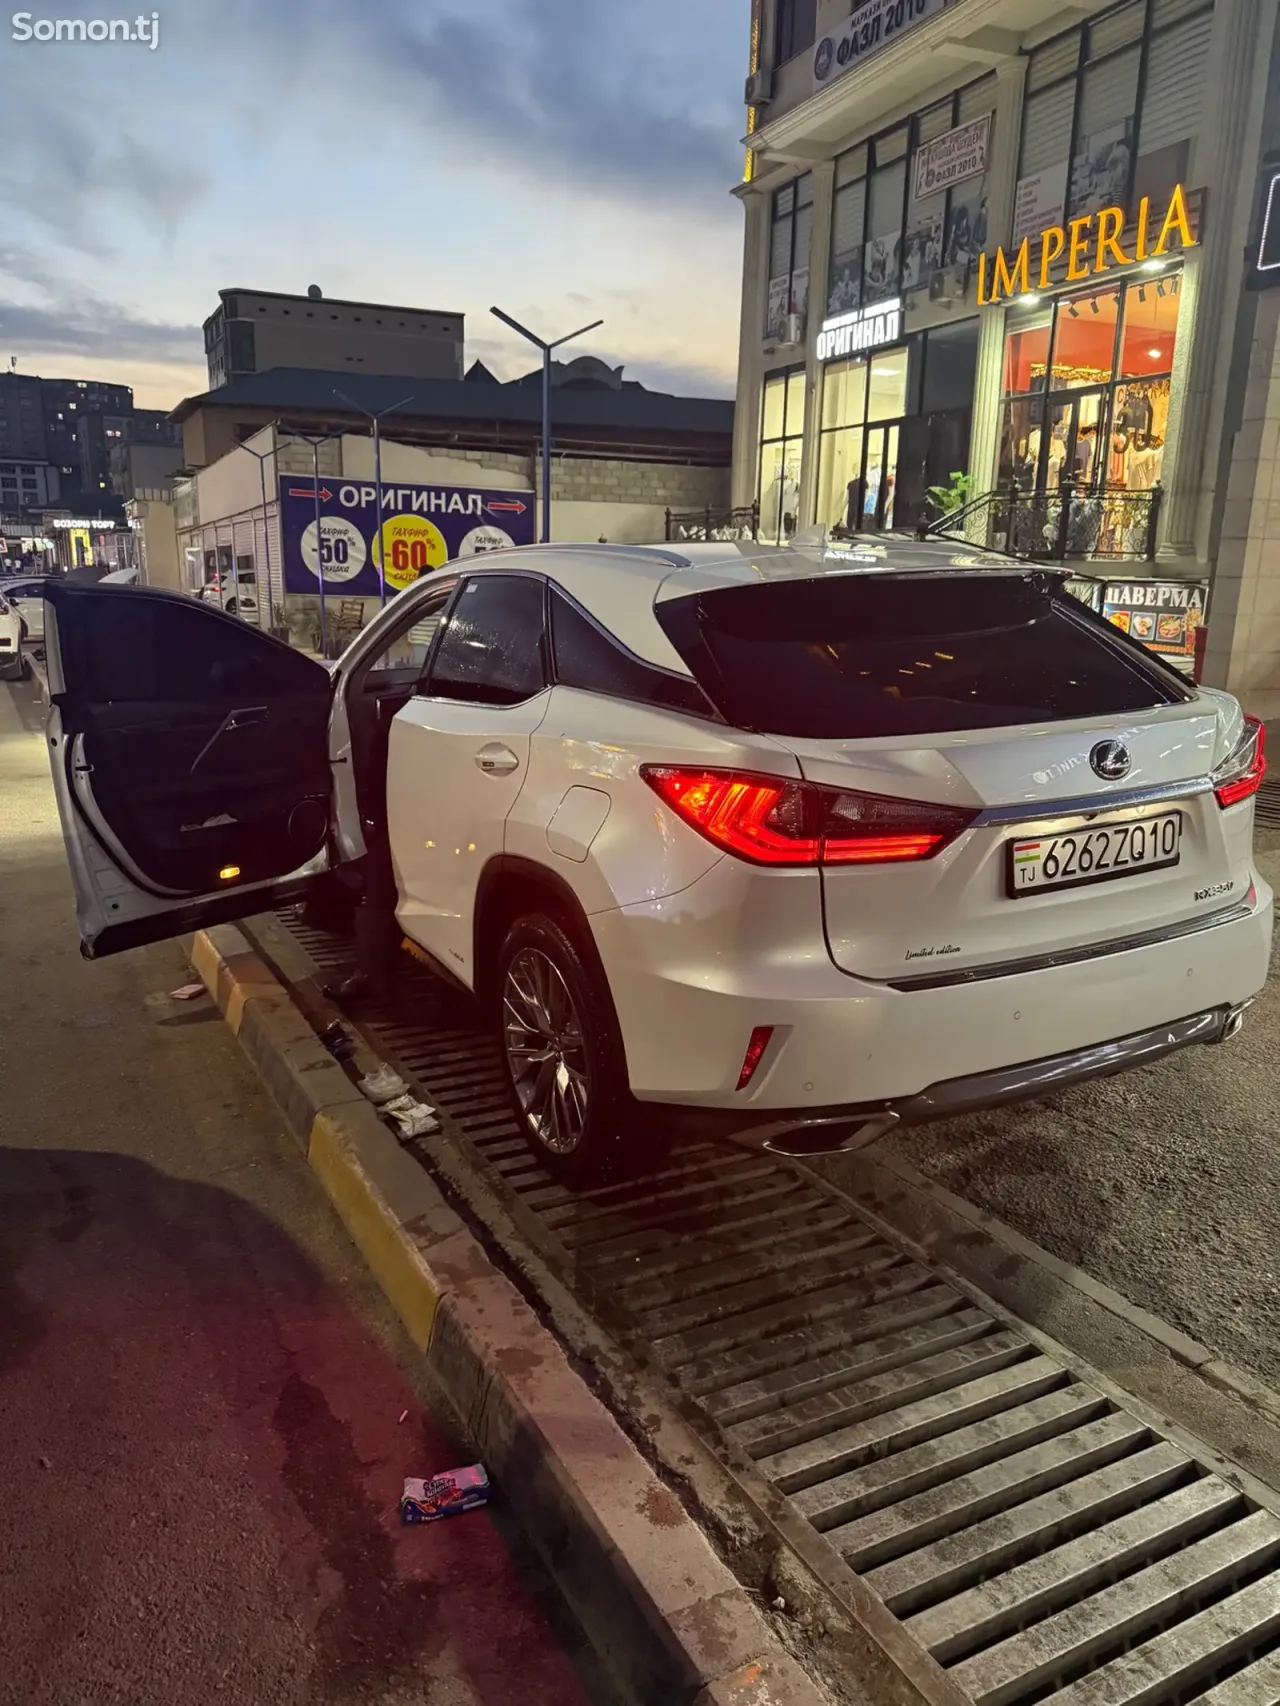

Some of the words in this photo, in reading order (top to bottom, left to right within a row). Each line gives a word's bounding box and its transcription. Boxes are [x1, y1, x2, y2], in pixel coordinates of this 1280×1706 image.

[837, 13, 882, 65] ФАЗЛ
[935, 164, 956, 183] ФАЗЛ
[957, 155, 977, 174] 2010
[977, 183, 1200, 306] IMPERIA
[816, 309, 900, 361] ОРИГИНАЛ
[339, 486, 483, 516] ОРИГИНАЛ
[1020, 866, 1036, 884] TJ
[1043, 819, 1176, 879] 6262ZQ10
